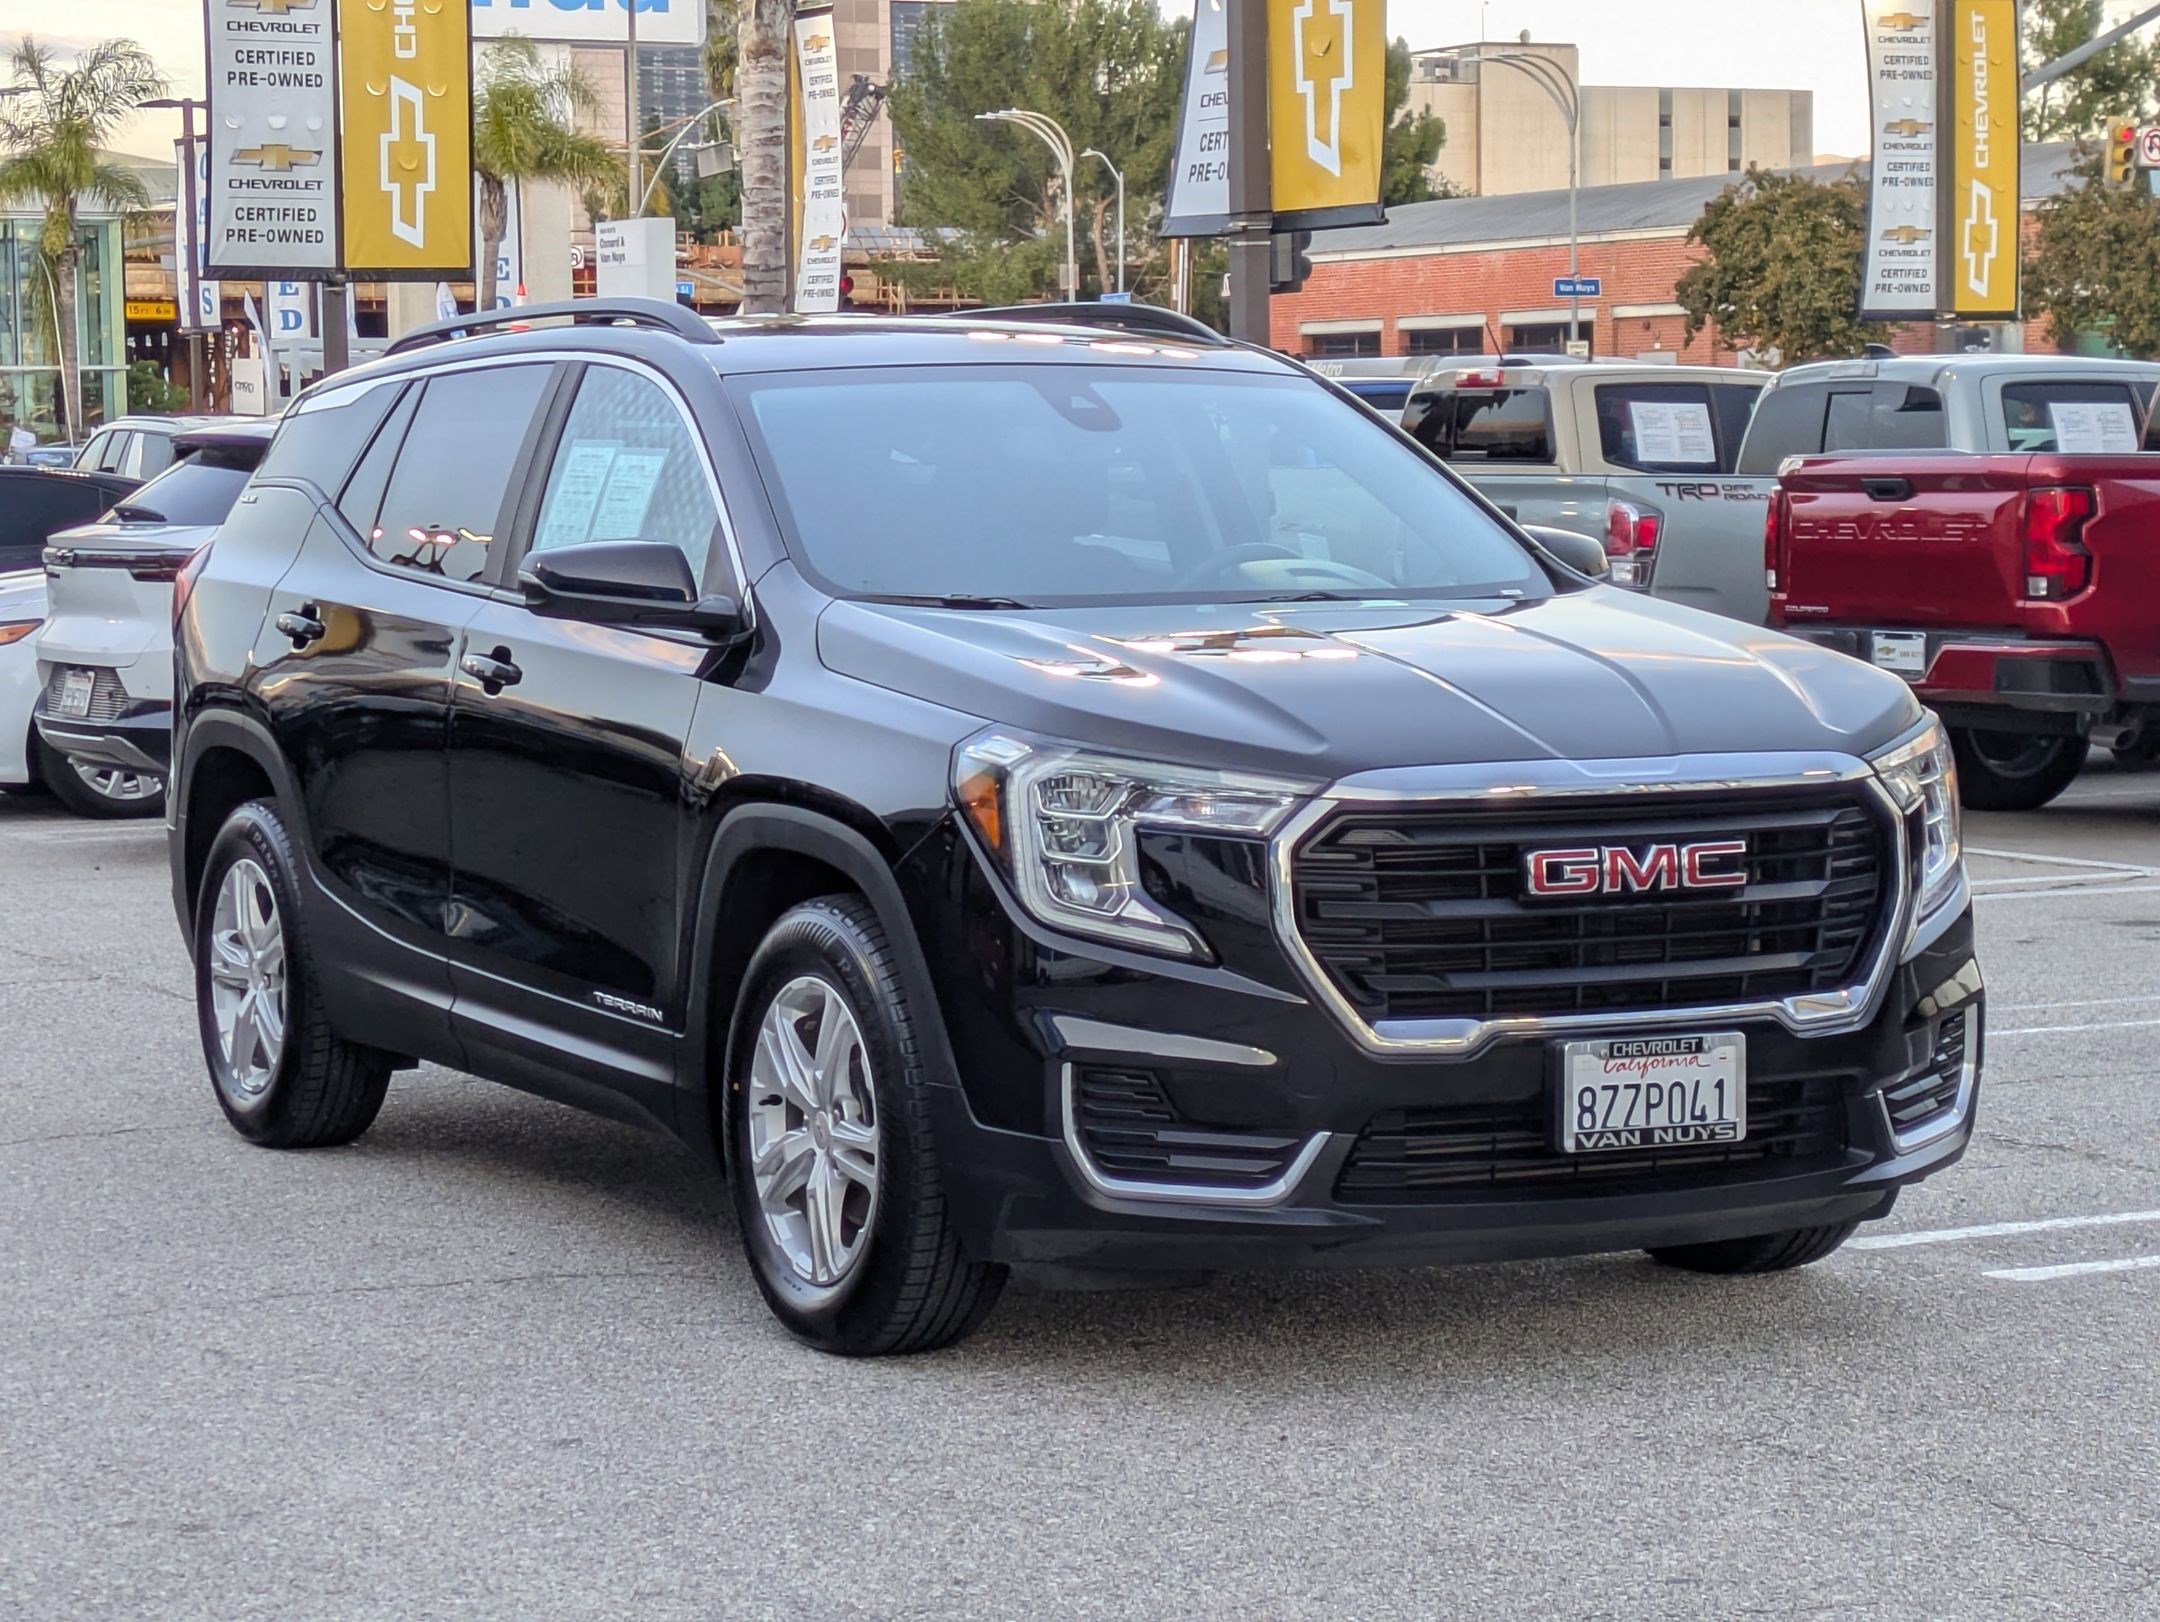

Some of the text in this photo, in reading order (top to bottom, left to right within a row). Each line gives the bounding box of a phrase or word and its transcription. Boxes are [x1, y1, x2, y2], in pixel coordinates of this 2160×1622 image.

[226, 20, 321, 34] CHEVROLET
[393, 0, 416, 58] CH
[1878, 36, 1931, 44] CHEVROLET
[235, 49, 316, 66] CERTIFIED
[1884, 55, 1929, 66] CERTIFIED
[227, 72, 323, 88] PRE-OWNED
[1880, 70, 1933, 80] PRE-OWNED
[1972, 10, 1989, 168] CHEVROLET
[1883, 142, 1933, 150] CHEVROLET
[1188, 162, 1229, 184] PRE-O
[1887, 161, 1931, 172] CERTIFIED
[228, 178, 324, 191] CHEVROLET
[1882, 176, 1934, 187] PRE-OWNED
[235, 207, 317, 222] CERTIFIED
[225, 228, 324, 244] PRE-OWNED
[1878, 249, 1931, 257] CHEVROLET
[1881, 268, 1927, 279] CERTIFIED
[1559, 284, 1596, 293] Van Nuys
[1874, 283, 1931, 294] PRE-OWNED
[1655, 482, 1754, 501] TRD OFF
[1723, 493, 1769, 501] ROAD
[1795, 523, 1987, 540] CHEVROLET
[1526, 840, 1747, 896] GMC
[593, 991, 663, 1022] TERRAIN
[1613, 1038, 1699, 1057] CHEVROLET
[1603, 1055, 1711, 1079] California
[1577, 1078, 1729, 1131] 8ZZP041
[1577, 1124, 1736, 1149] VAN NUYS
